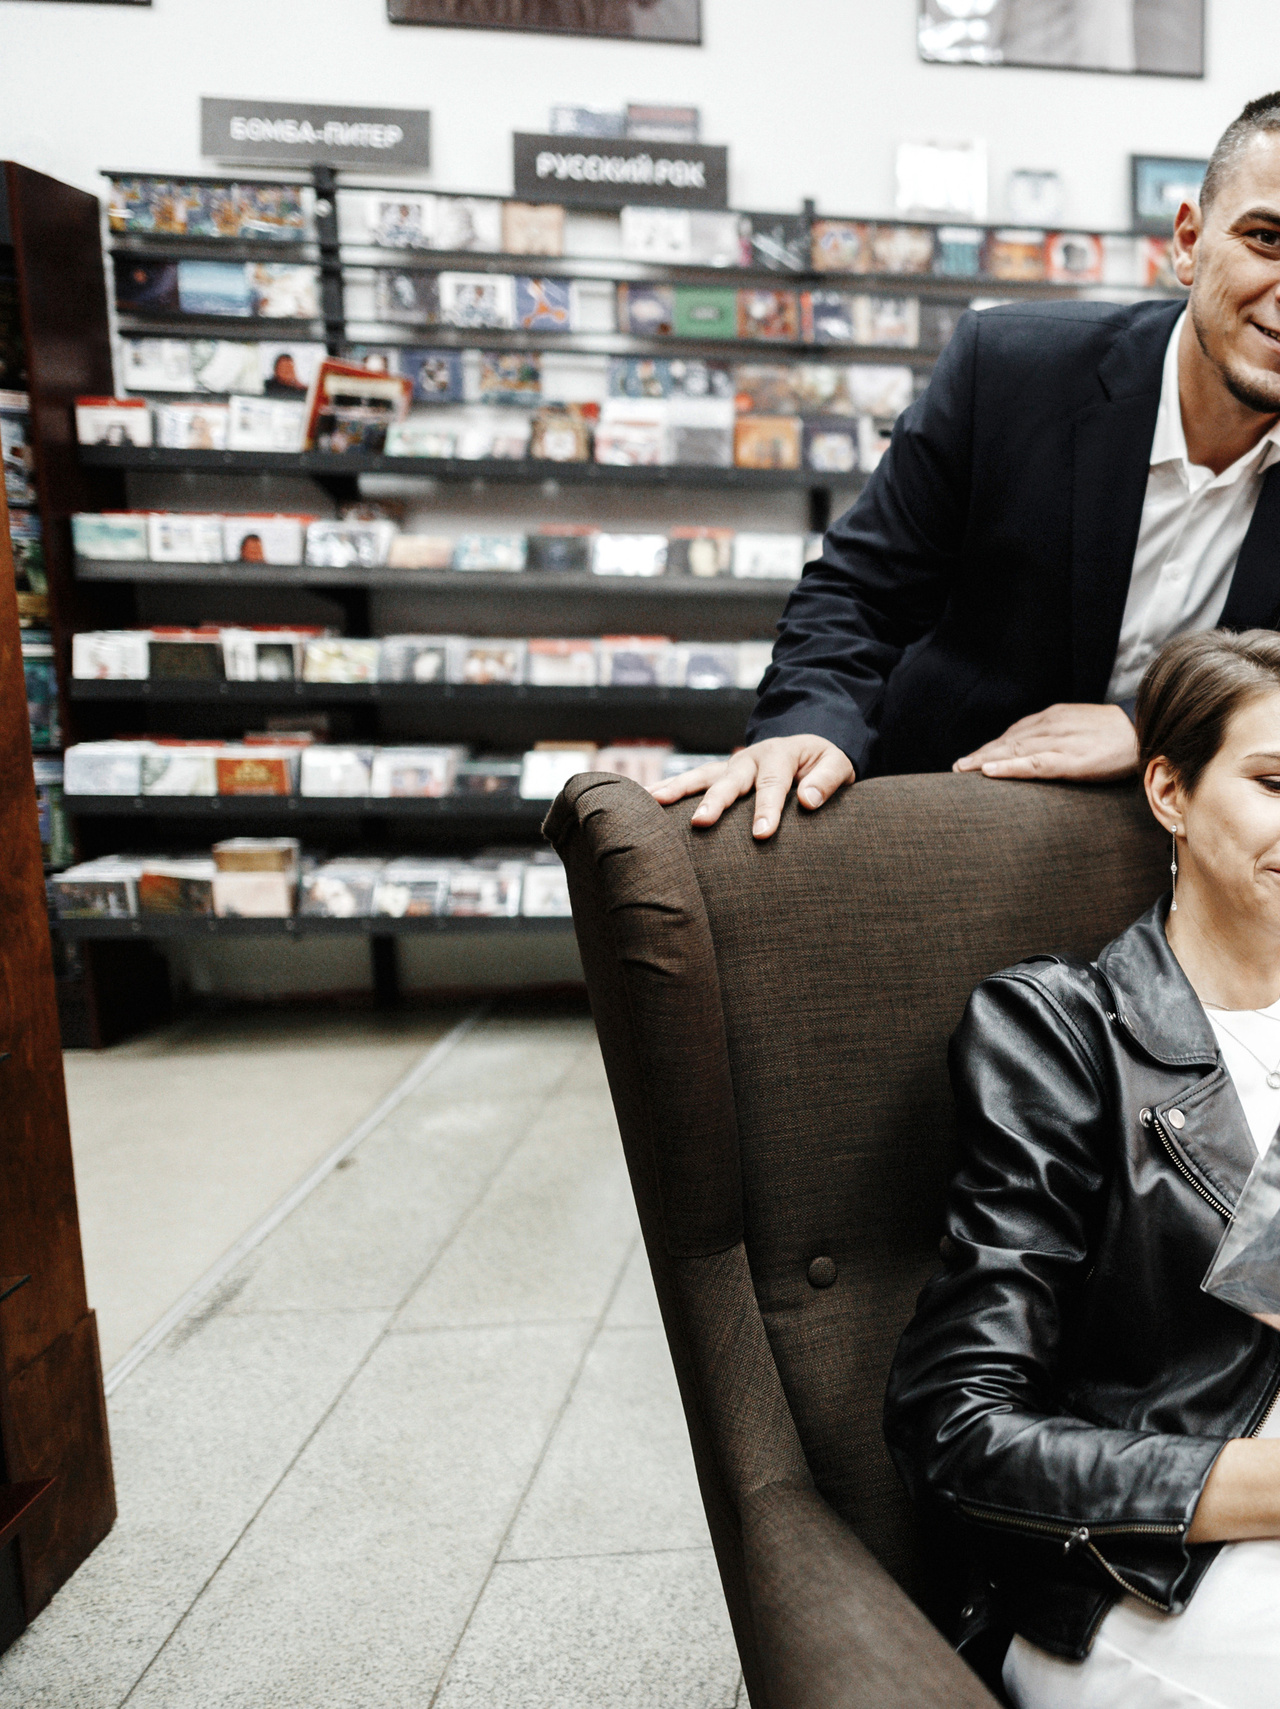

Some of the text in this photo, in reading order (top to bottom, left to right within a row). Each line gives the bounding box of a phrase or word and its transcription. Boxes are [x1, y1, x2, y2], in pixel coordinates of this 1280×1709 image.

[229, 116, 404, 149] БОМБА-ПИТЕР
[535, 151, 706, 188] РУССКИЙ РОК
